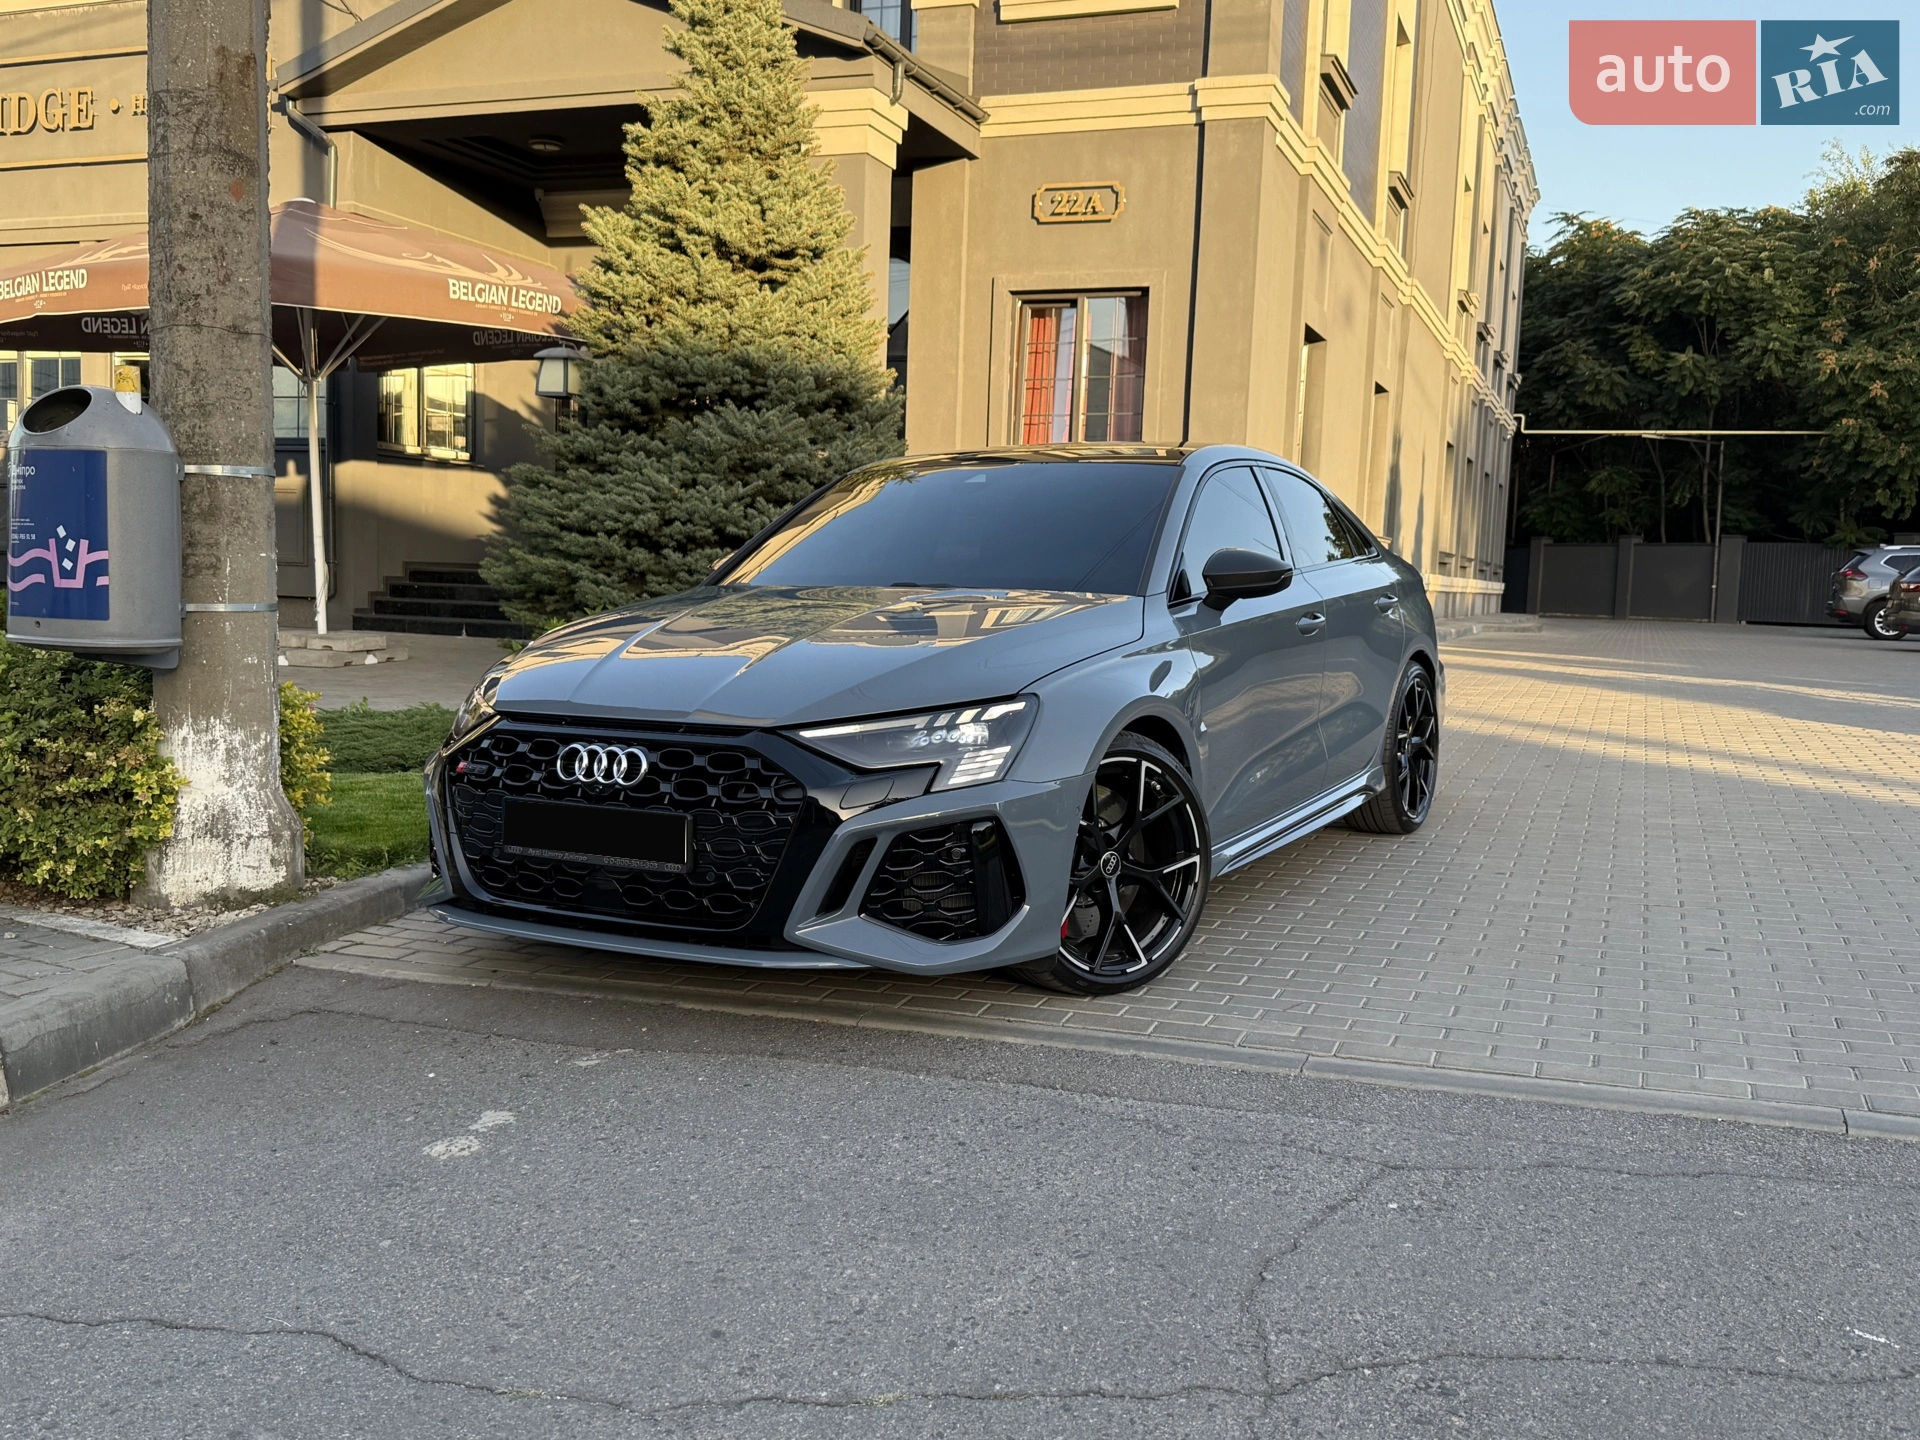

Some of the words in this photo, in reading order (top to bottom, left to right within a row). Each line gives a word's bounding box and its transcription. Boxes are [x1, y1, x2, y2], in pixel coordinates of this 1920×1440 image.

[41, 268, 88, 292] LEGEND
[447, 278, 509, 306] BELGIAN
[511, 286, 562, 314] LEGEND
